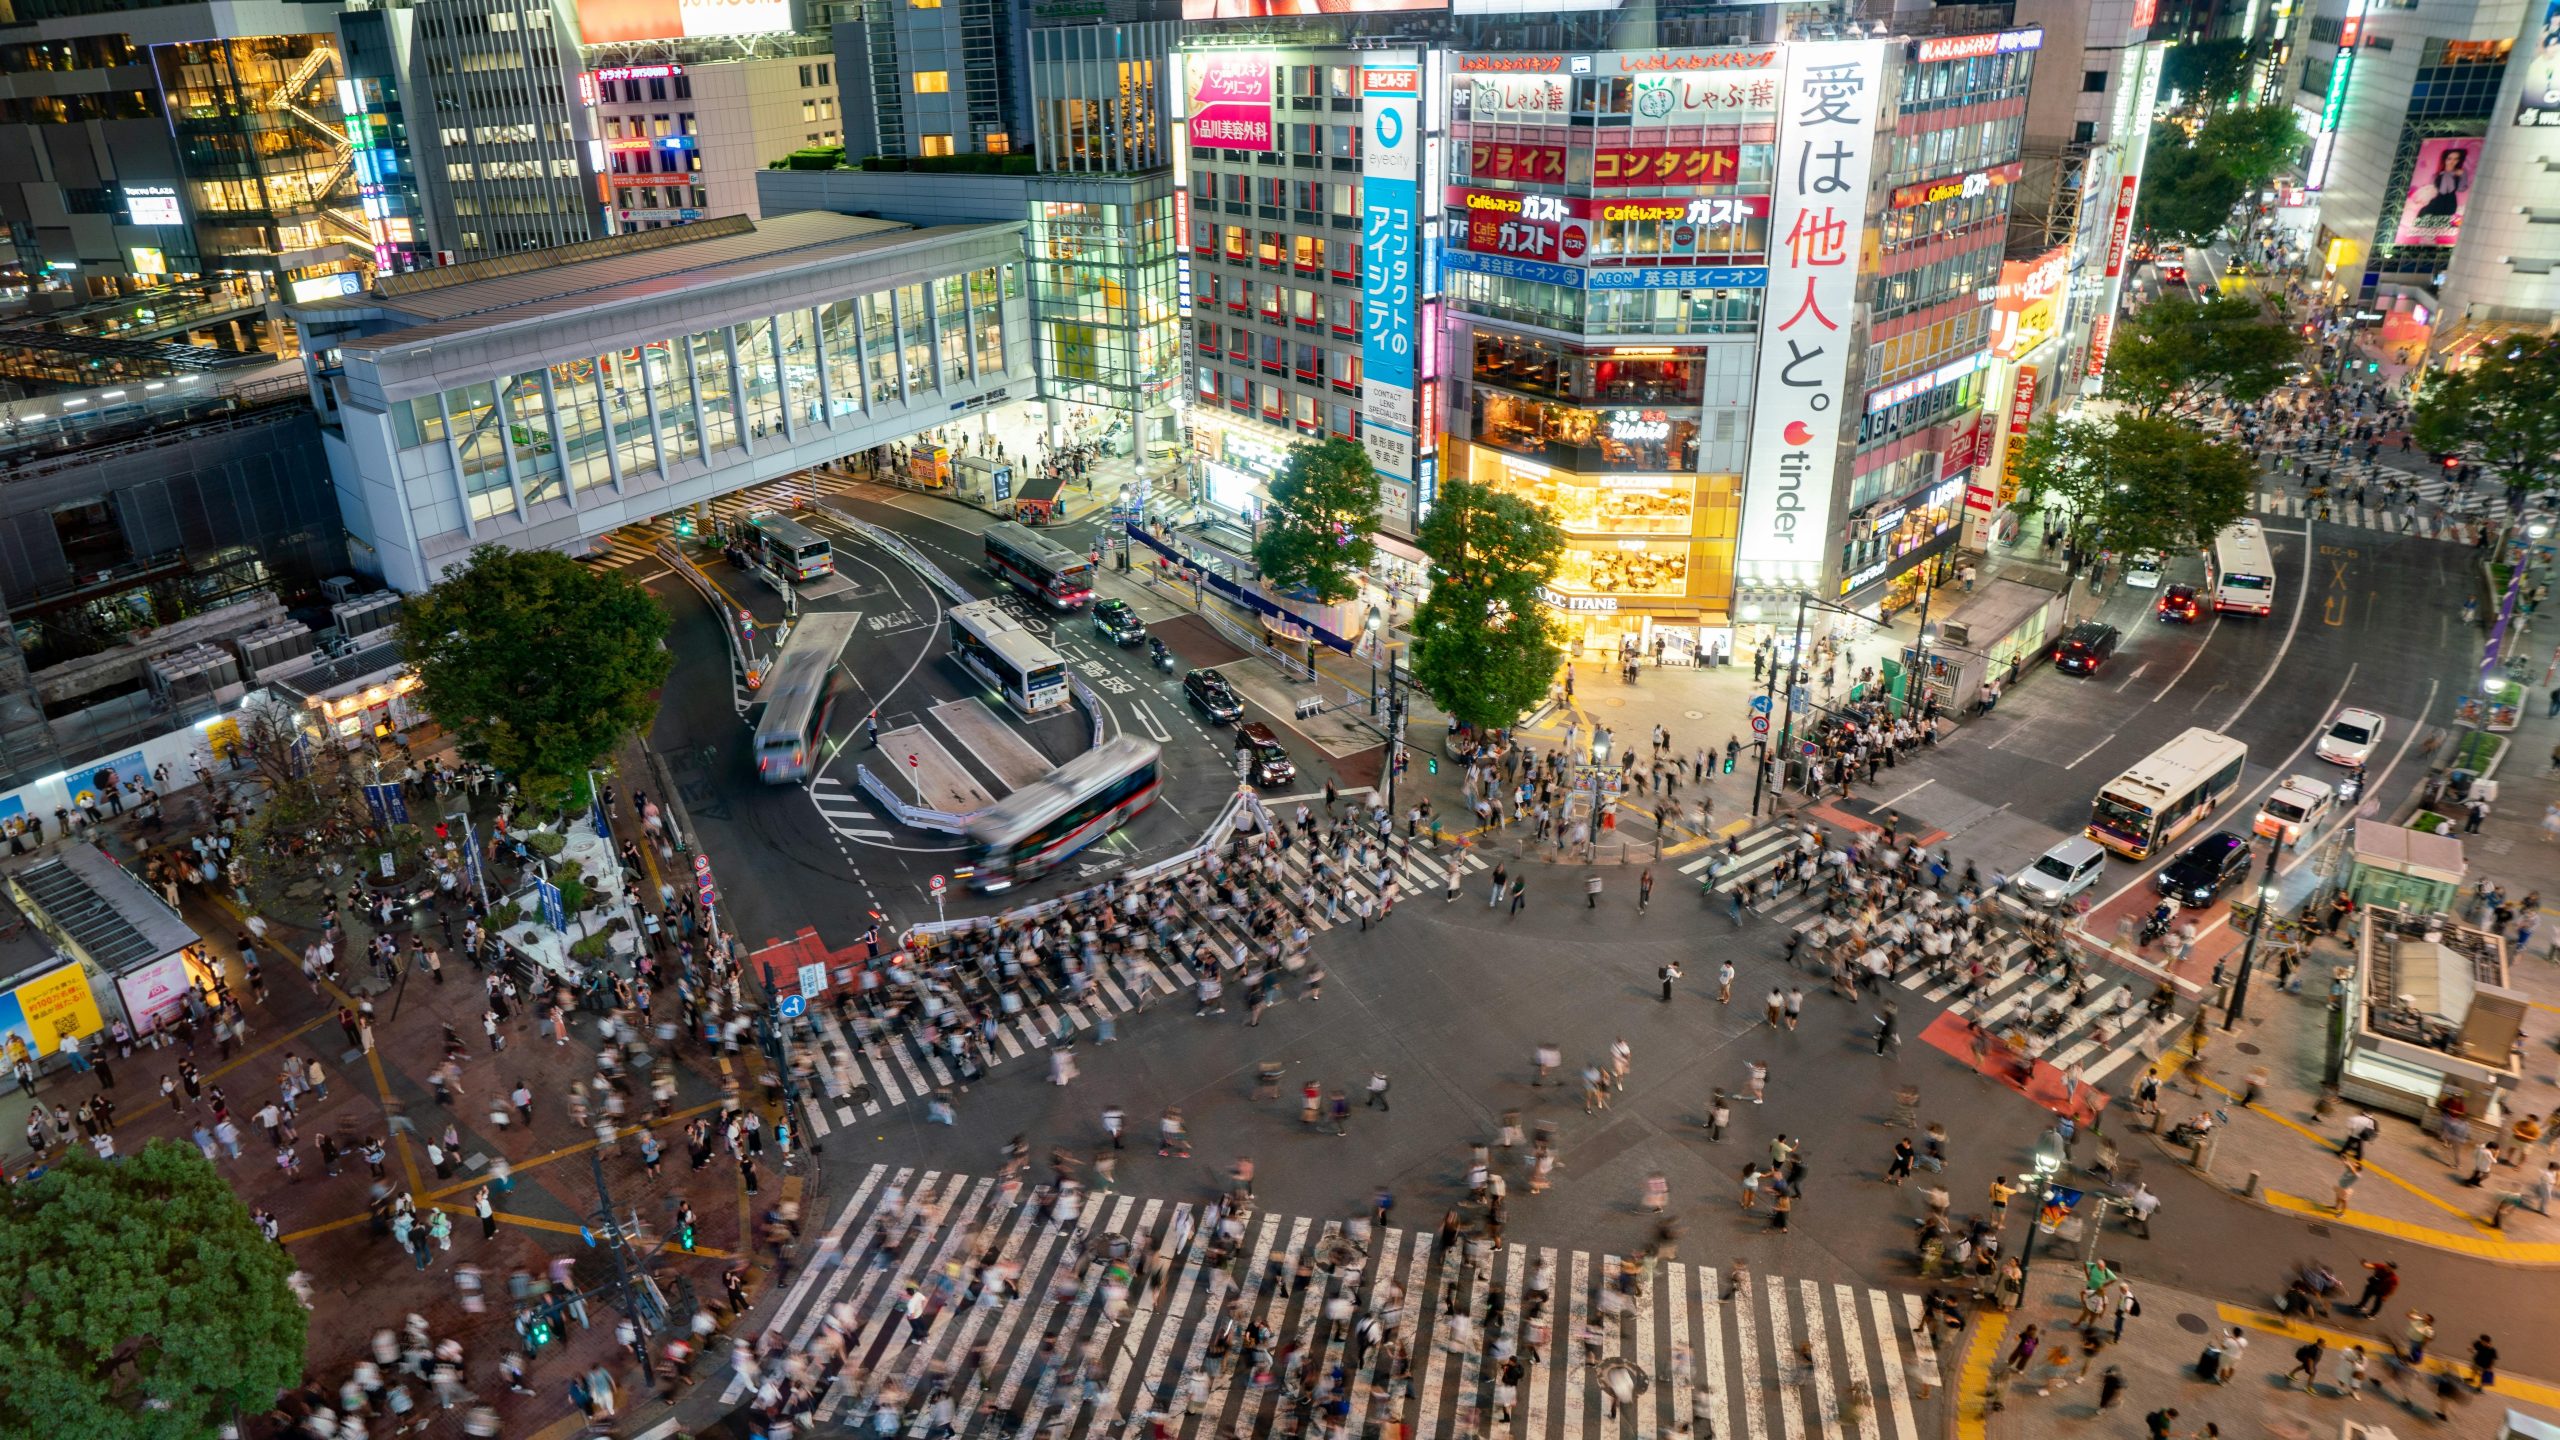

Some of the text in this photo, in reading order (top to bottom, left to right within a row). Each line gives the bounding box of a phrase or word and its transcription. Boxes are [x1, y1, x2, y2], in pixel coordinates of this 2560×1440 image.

[1223, 80, 1262, 95] クリニック
[1368, 72, 1411, 88] 当ビル5F
[1453, 88, 1470, 105] 9F
[1505, 83, 1564, 111] しゃぶ葉
[1684, 78, 1774, 109] しゃぶ葉
[1199, 120, 1267, 142] 品川美容外科
[1368, 153, 1410, 171] eyecity
[1595, 150, 1734, 177] コンタクト
[150, 187, 175, 195] PLAZA
[1522, 195, 1570, 222] ガスト
[1686, 199, 1754, 225] ガスト
[1450, 219, 1468, 238] 7F
[1473, 222, 1497, 237] Café
[1498, 221, 1555, 256] ガスト
[1778, 61, 1865, 412] 愛は他人と。
[1368, 205, 1390, 351] アイシティ
[1480, 257, 1559, 281] 英会話イーオン
[1596, 272, 1633, 284] AEON
[1644, 270, 1763, 287] 英会話イーオン
[1391, 208, 1409, 355] コンタクトの
[1373, 388, 1402, 402] CONTACT
[1379, 398, 1395, 410] LENS
[1368, 405, 1407, 423] SPECIALISTS
[1949, 435, 1971, 460] アコム
[1774, 450, 1812, 544] tinder
